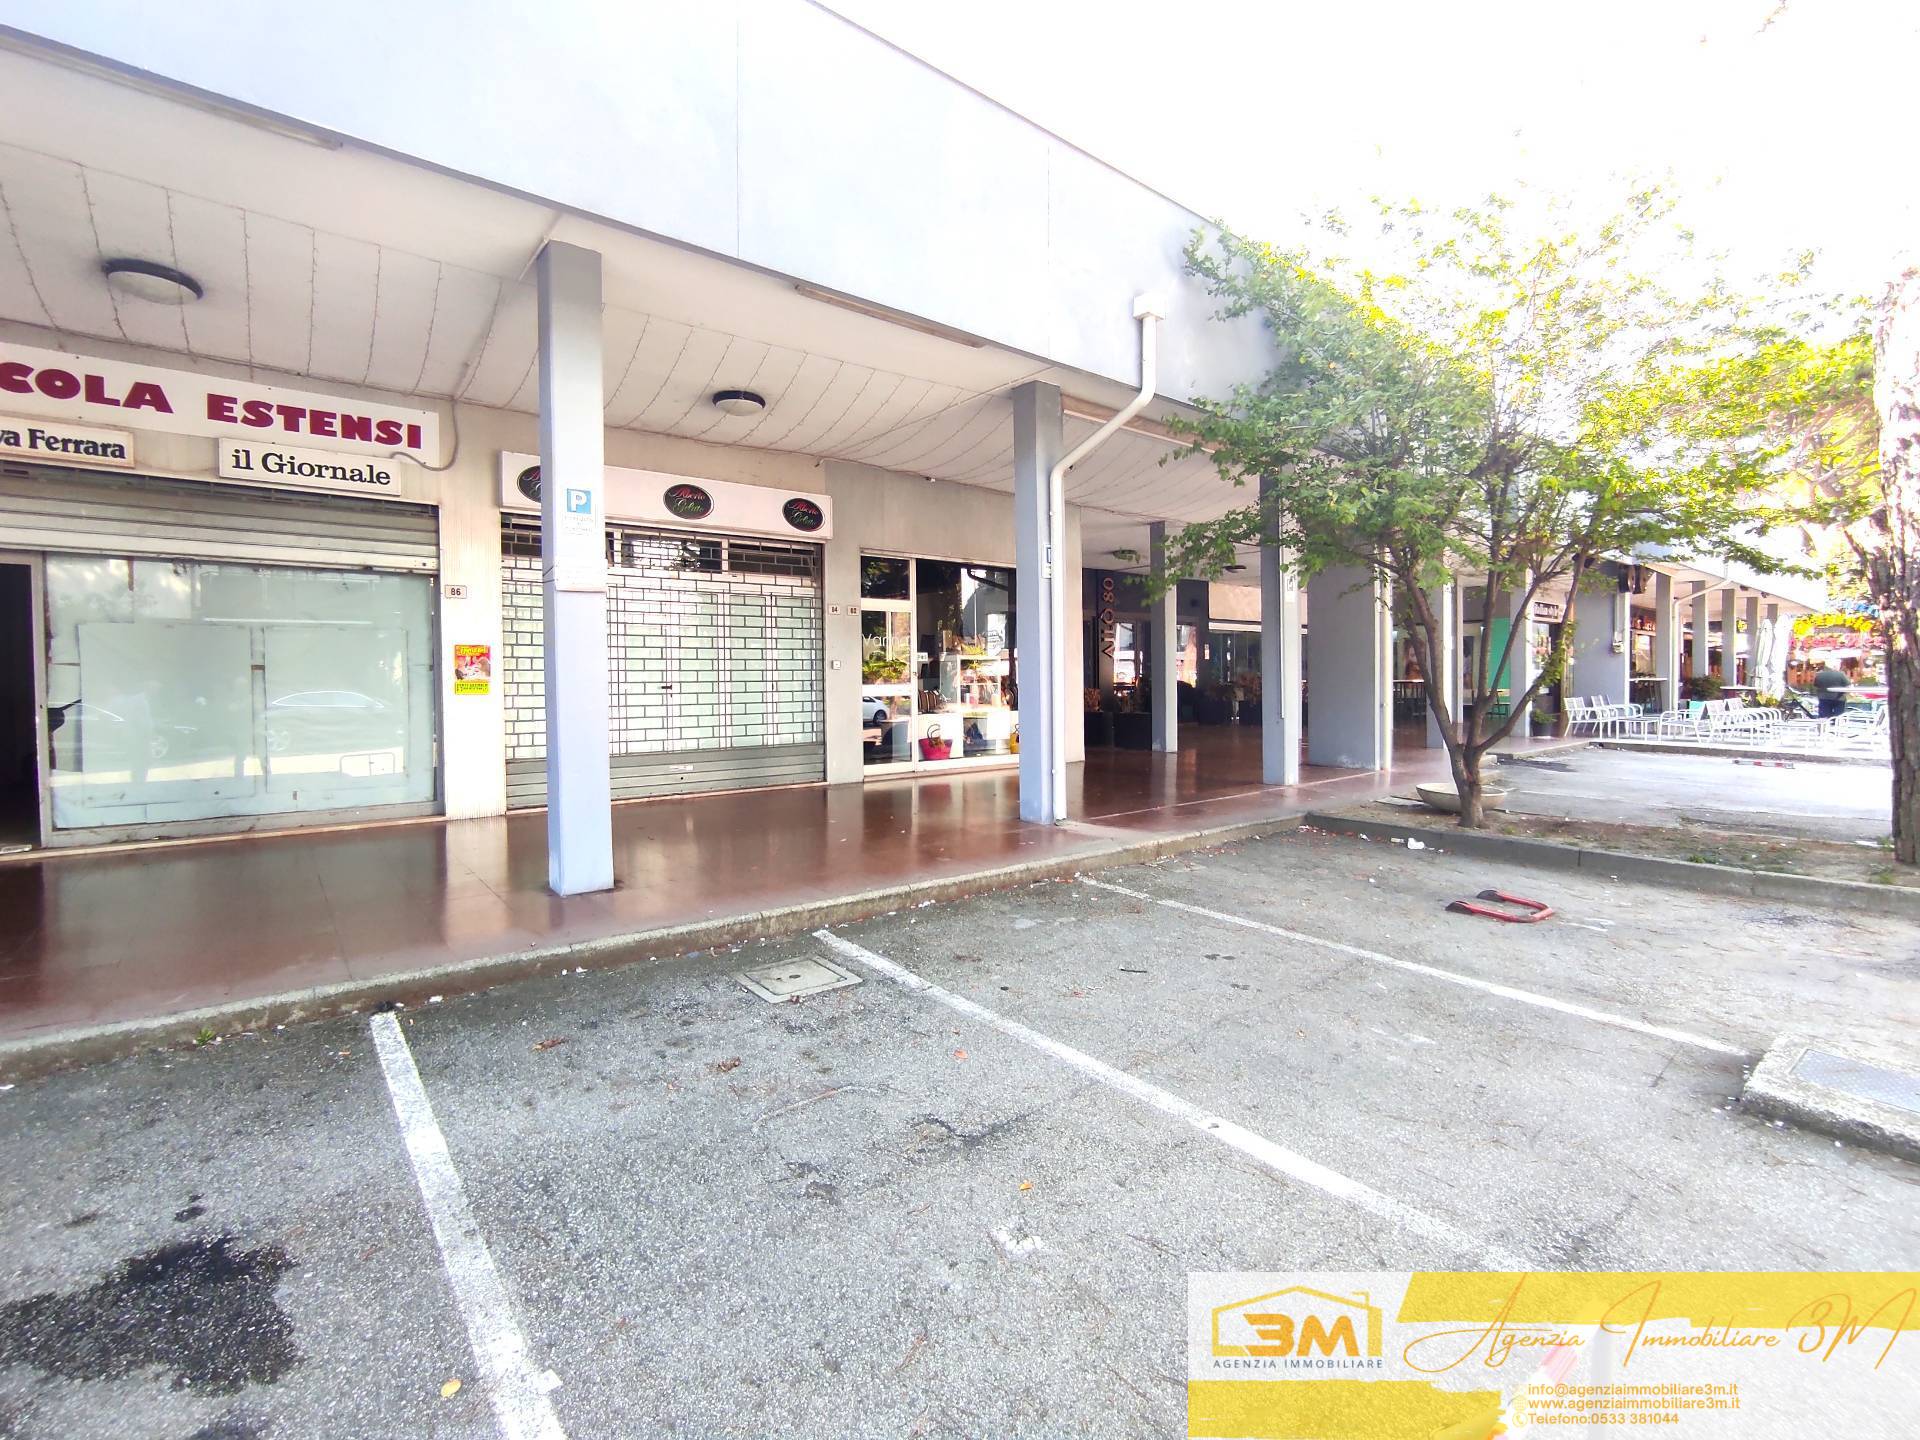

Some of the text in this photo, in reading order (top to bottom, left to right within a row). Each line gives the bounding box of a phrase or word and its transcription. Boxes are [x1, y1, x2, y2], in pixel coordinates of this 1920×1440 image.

[0, 362, 422, 449] COLA ESTENSI
[27, 428, 126, 459] Ferrara
[232, 449, 391, 486] il Giornale
[570, 490, 587, 512] P
[450, 587, 461, 596] 86
